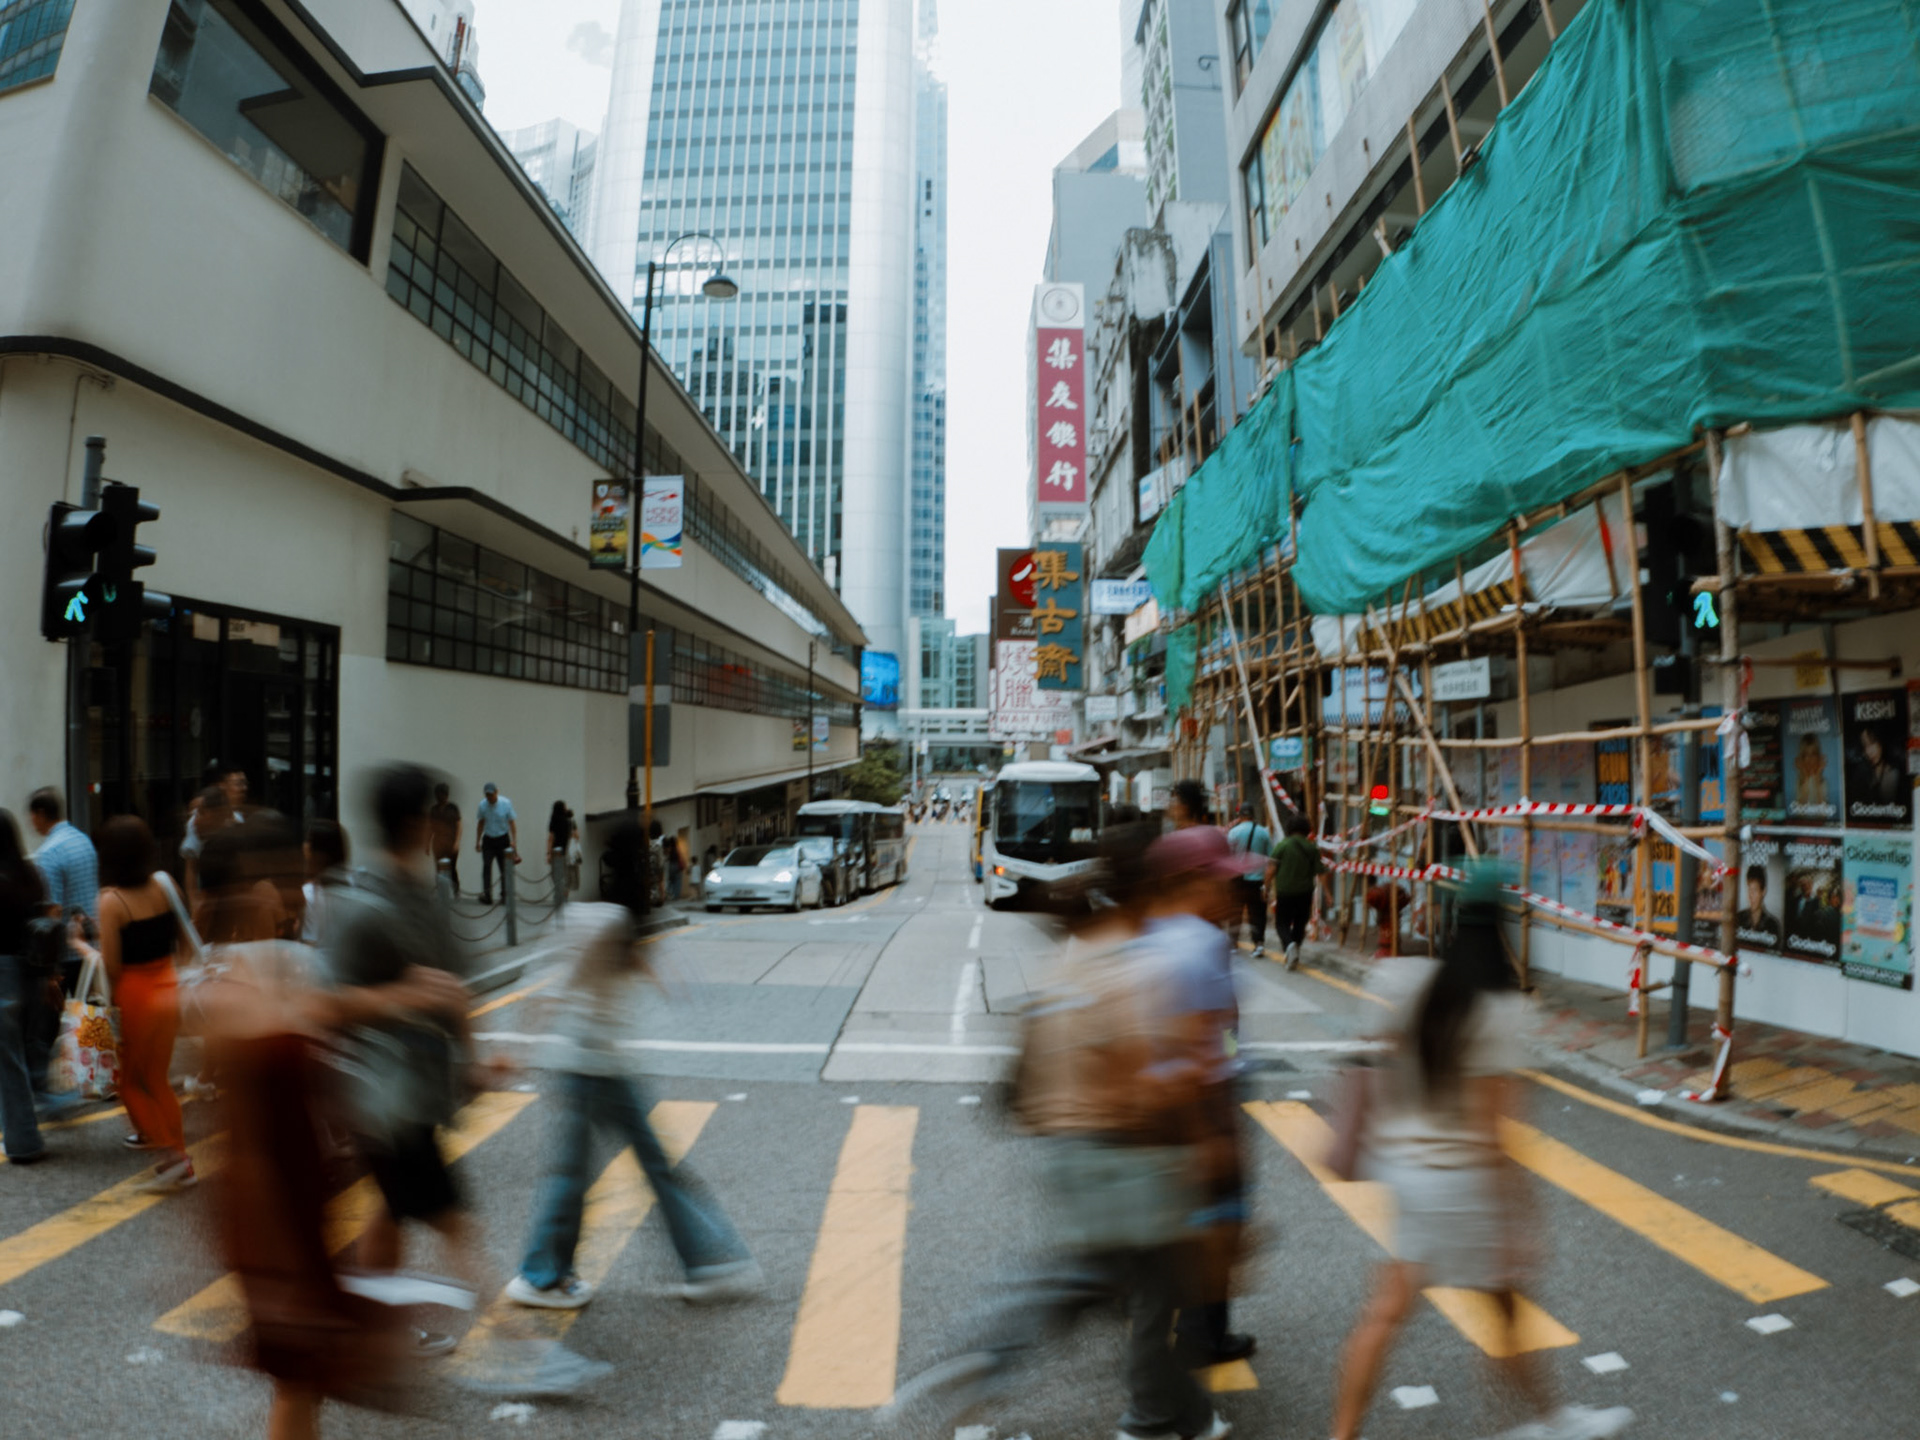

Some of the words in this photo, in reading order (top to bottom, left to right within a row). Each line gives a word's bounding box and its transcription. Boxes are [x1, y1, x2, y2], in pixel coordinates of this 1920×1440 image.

[1044, 336, 1078, 492] 集友銀行
[1855, 699, 1896, 722] KESHI
[1847, 845, 1912, 867] Clockenflap
